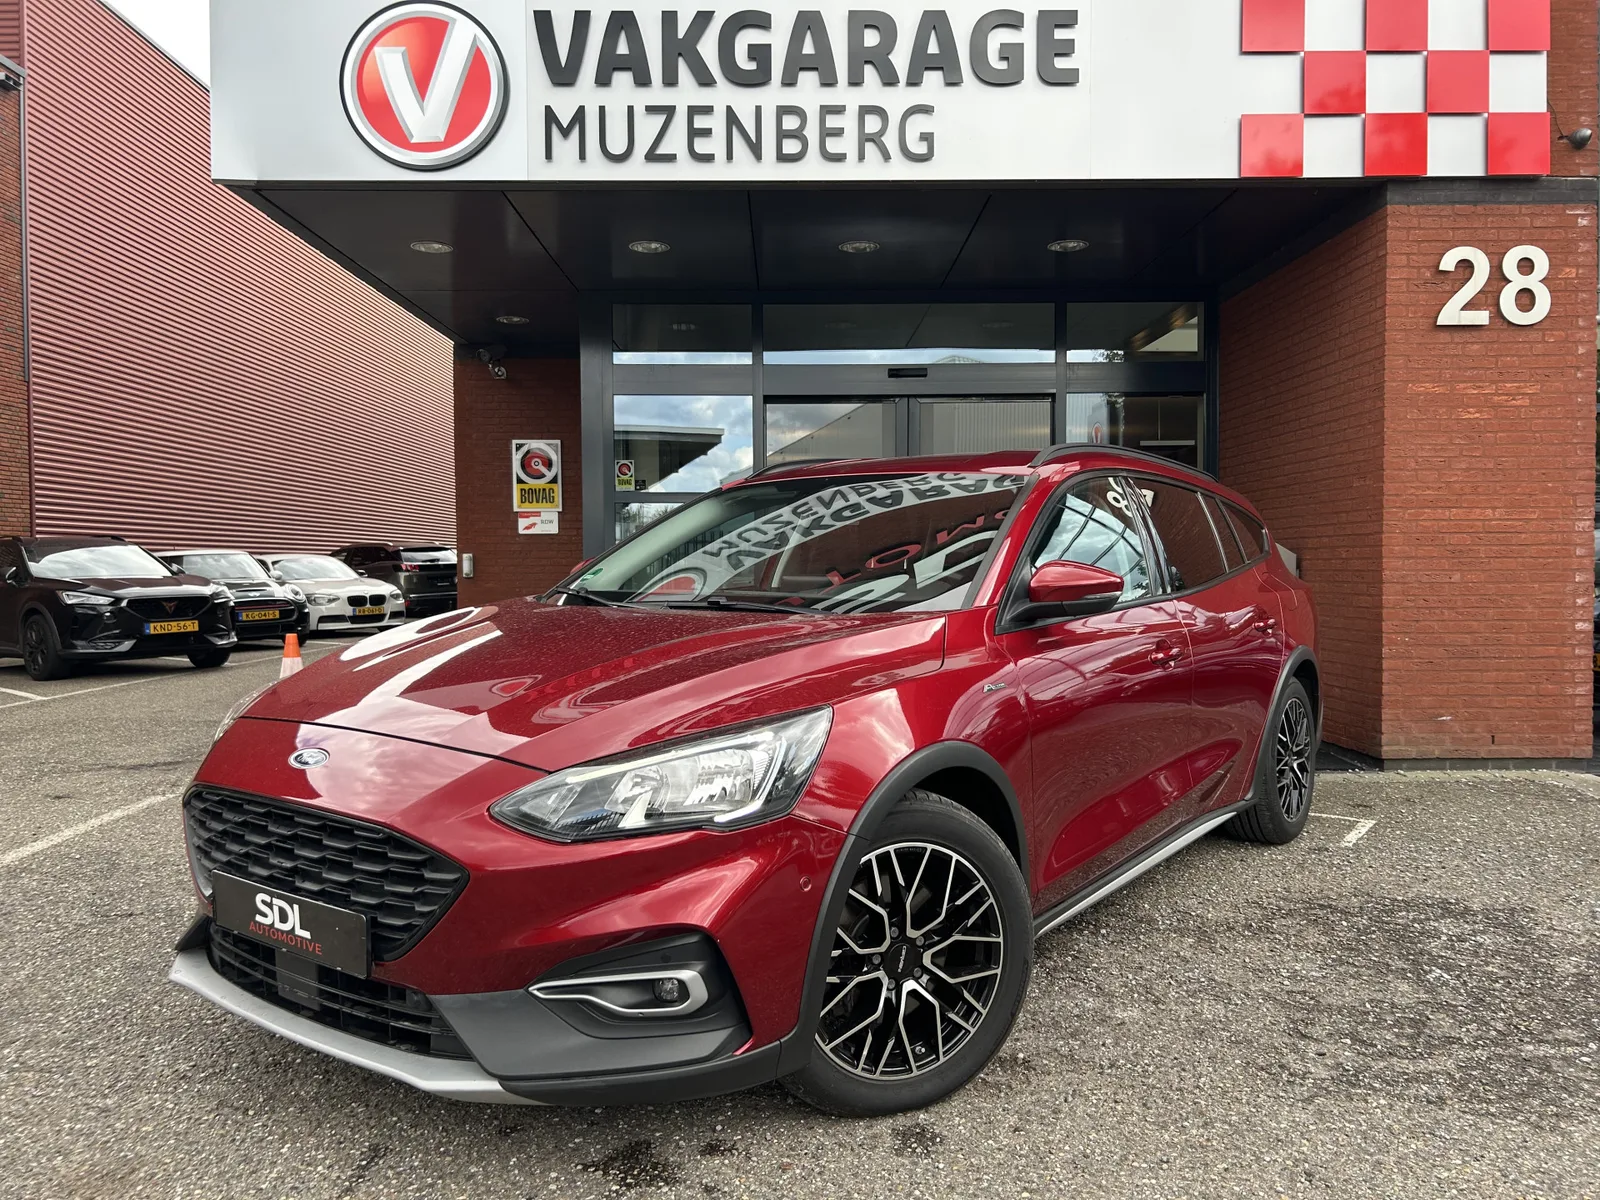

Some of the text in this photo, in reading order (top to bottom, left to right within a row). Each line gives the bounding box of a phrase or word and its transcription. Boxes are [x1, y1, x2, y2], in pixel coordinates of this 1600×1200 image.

[533, 9, 1080, 87] VAKGARAGE
[544, 104, 935, 162] MUZENBERG
[1436, 244, 1552, 326] 28
[520, 487, 555, 504] BOVAG
[153, 622, 196, 632] KND-56-T
[246, 611, 277, 619] KG-041-S
[255, 892, 312, 939] SDL
[249, 921, 323, 955] AUTOMOTIVE
